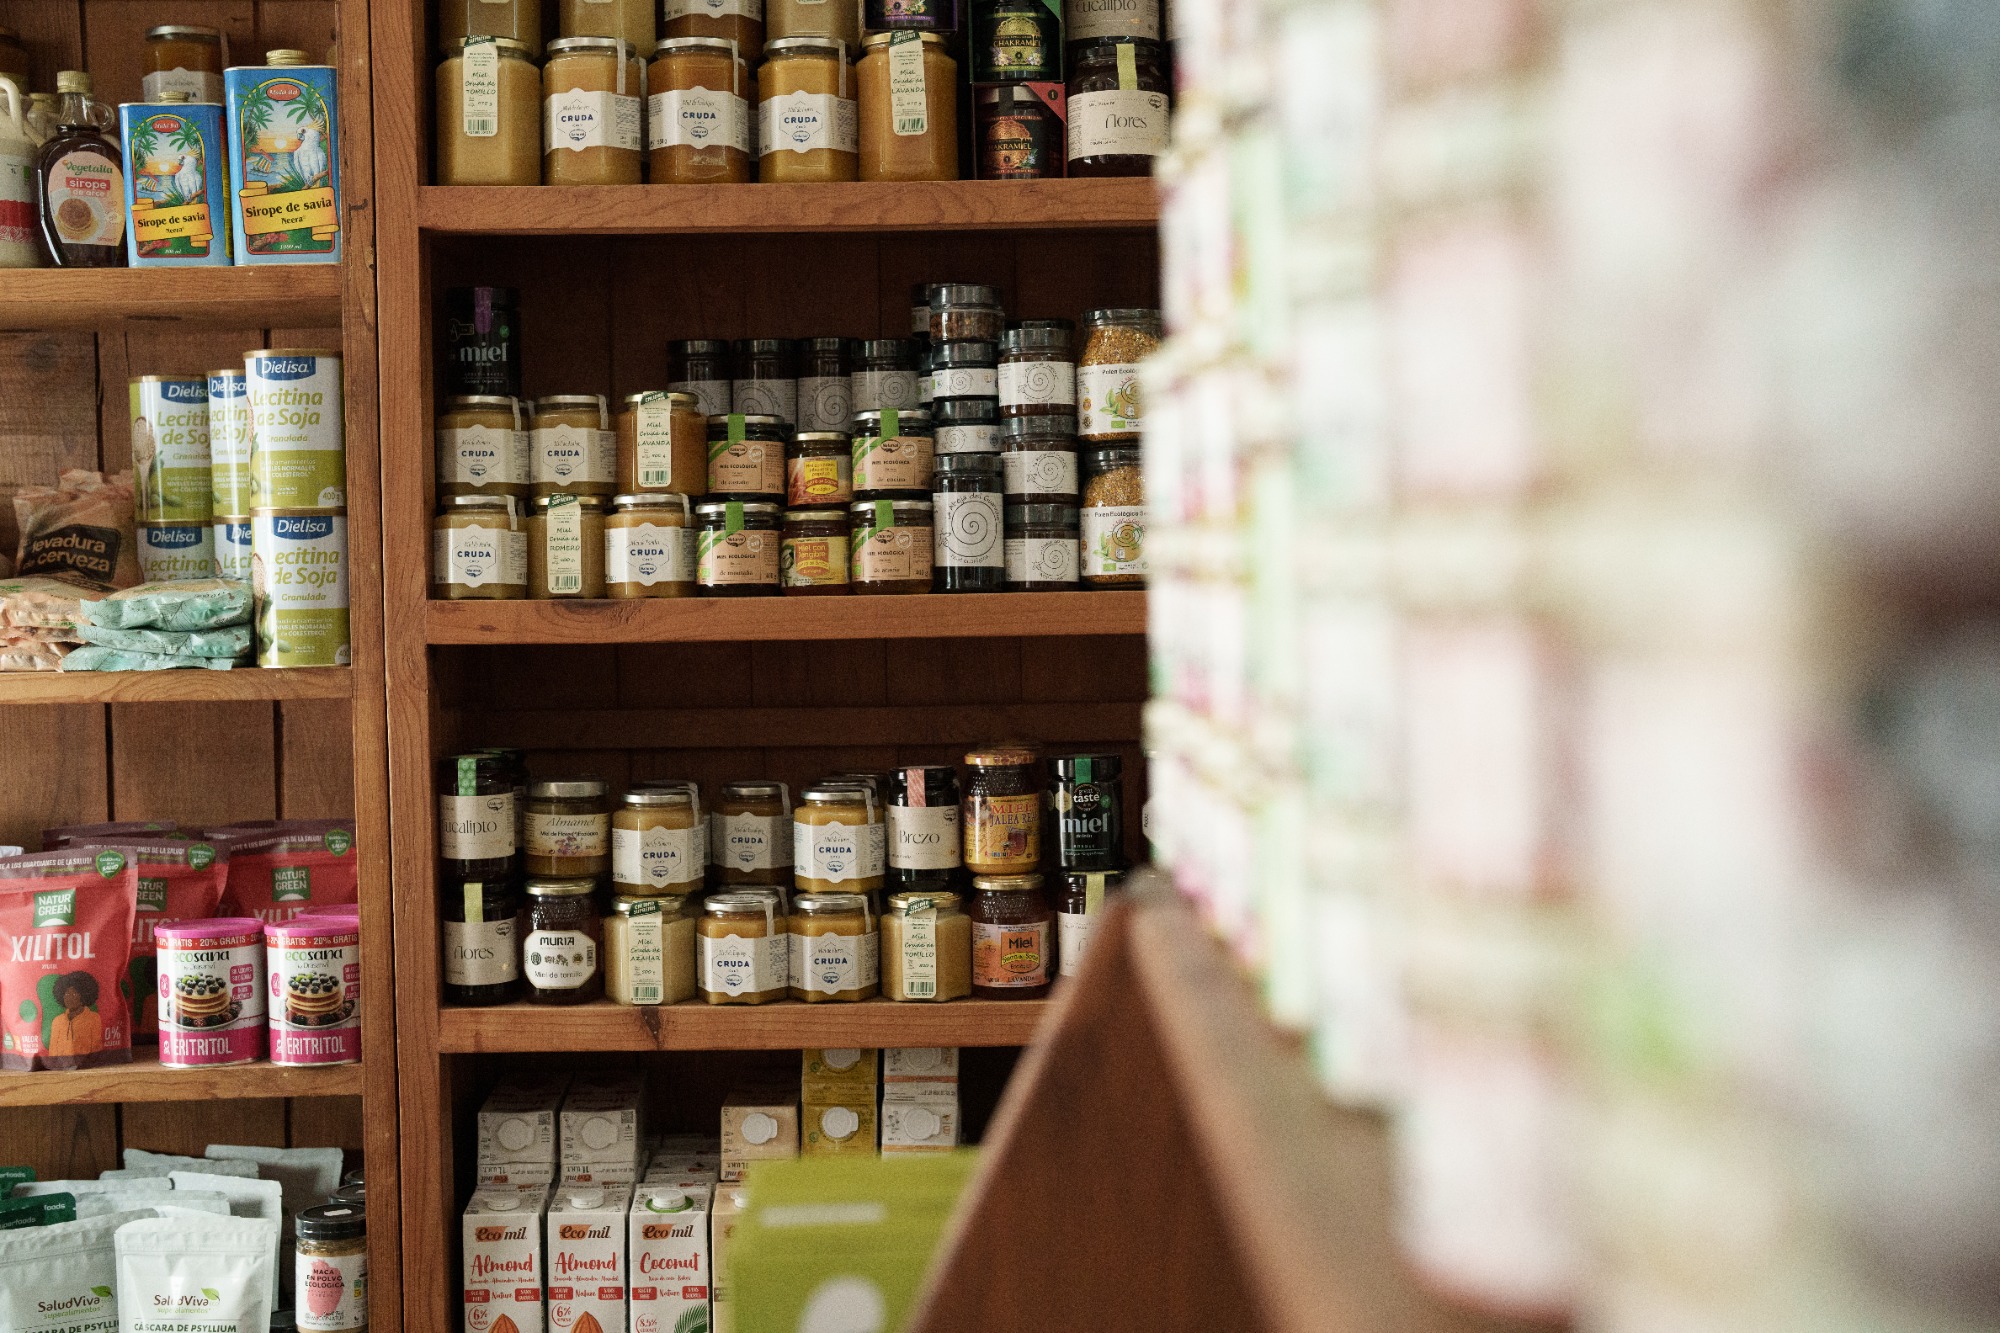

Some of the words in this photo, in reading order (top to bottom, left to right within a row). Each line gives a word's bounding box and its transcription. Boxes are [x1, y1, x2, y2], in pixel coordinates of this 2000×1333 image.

[560, 115, 594, 123] CRUDA
[682, 111, 717, 119] CRUDA
[784, 116, 818, 124] CRUDA
[65, 162, 113, 176] Vegetalia
[69, 178, 107, 190] sirope
[245, 205, 283, 218] Sirope
[286, 201, 301, 213] de
[303, 197, 333, 210] savia
[137, 217, 167, 229] Sirope
[169, 215, 180, 224] de
[182, 212, 206, 222] savia
[460, 341, 508, 362] miel
[261, 360, 308, 374] Dielisa
[253, 387, 323, 406] Lecitina
[157, 411, 210, 427] Leciti
[256, 409, 275, 426] de
[277, 408, 320, 430] Soja
[162, 428, 185, 445] de
[277, 519, 326, 533] Dielisa
[152, 530, 195, 543] Dielisa
[32, 534, 107, 554] levadura
[275, 546, 340, 565] ecitina
[457, 550, 491, 558] CRUDA
[630, 549, 664, 557] CRUDA
[37, 551, 111, 573] cerveza
[144, 554, 208, 572] Lecitina
[295, 567, 337, 589] Soja
[281, 592, 326, 601] Granulada
[1072, 793, 1100, 803] taste
[991, 803, 1032, 815] MIEL
[442, 819, 498, 836] ucalipto
[989, 814, 1020, 828] JALEA
[1061, 812, 1108, 833] miel
[731, 836, 763, 844] CRUDA
[899, 829, 940, 845] Brezo
[642, 851, 676, 859] CRUDA
[818, 846, 852, 854] CRUDA
[275, 870, 306, 881] NATUR
[137, 881, 163, 891] ATUR
[275, 880, 307, 891] GREEN
[38, 893, 72, 905] NATUR
[38, 903, 72, 916] GREEN
[199, 938, 218, 947] 20%
[219, 935, 246, 946] GRATIS
[313, 936, 331, 945] 20%
[332, 933, 358, 944] GRATIS
[1008, 936, 1034, 949] Miel
[10, 932, 96, 963] XILITOL
[174, 950, 230, 963] ecosana
[285, 949, 343, 962] ecosana
[814, 957, 848, 965] CRUDA
[716, 960, 750, 968] CRUDA
[104, 1026, 121, 1040] 0%
[174, 1037, 233, 1056] ERITRITOL
[286, 1035, 347, 1056] ERITRITOL
[470, 1252, 533, 1277] Almond
[554, 1251, 617, 1275] Almond
[640, 1251, 701, 1274] Coconut
[491, 1291, 513, 1300] Nature
[575, 1289, 597, 1298] Nature
[659, 1289, 680, 1298] Nature
[38, 1295, 100, 1313] SaludViva
[44, 1306, 101, 1320] superalimentos
[156, 1307, 208, 1315] supealimentos
[473, 1307, 488, 1319] 6%
[556, 1306, 572, 1317] 6%
[84, 1319, 119, 1331] PSYLLI
[134, 1321, 175, 1332] CÁSCARA
[176, 1324, 189, 1332] DE
[191, 1323, 237, 1333] PSYLLIUM
